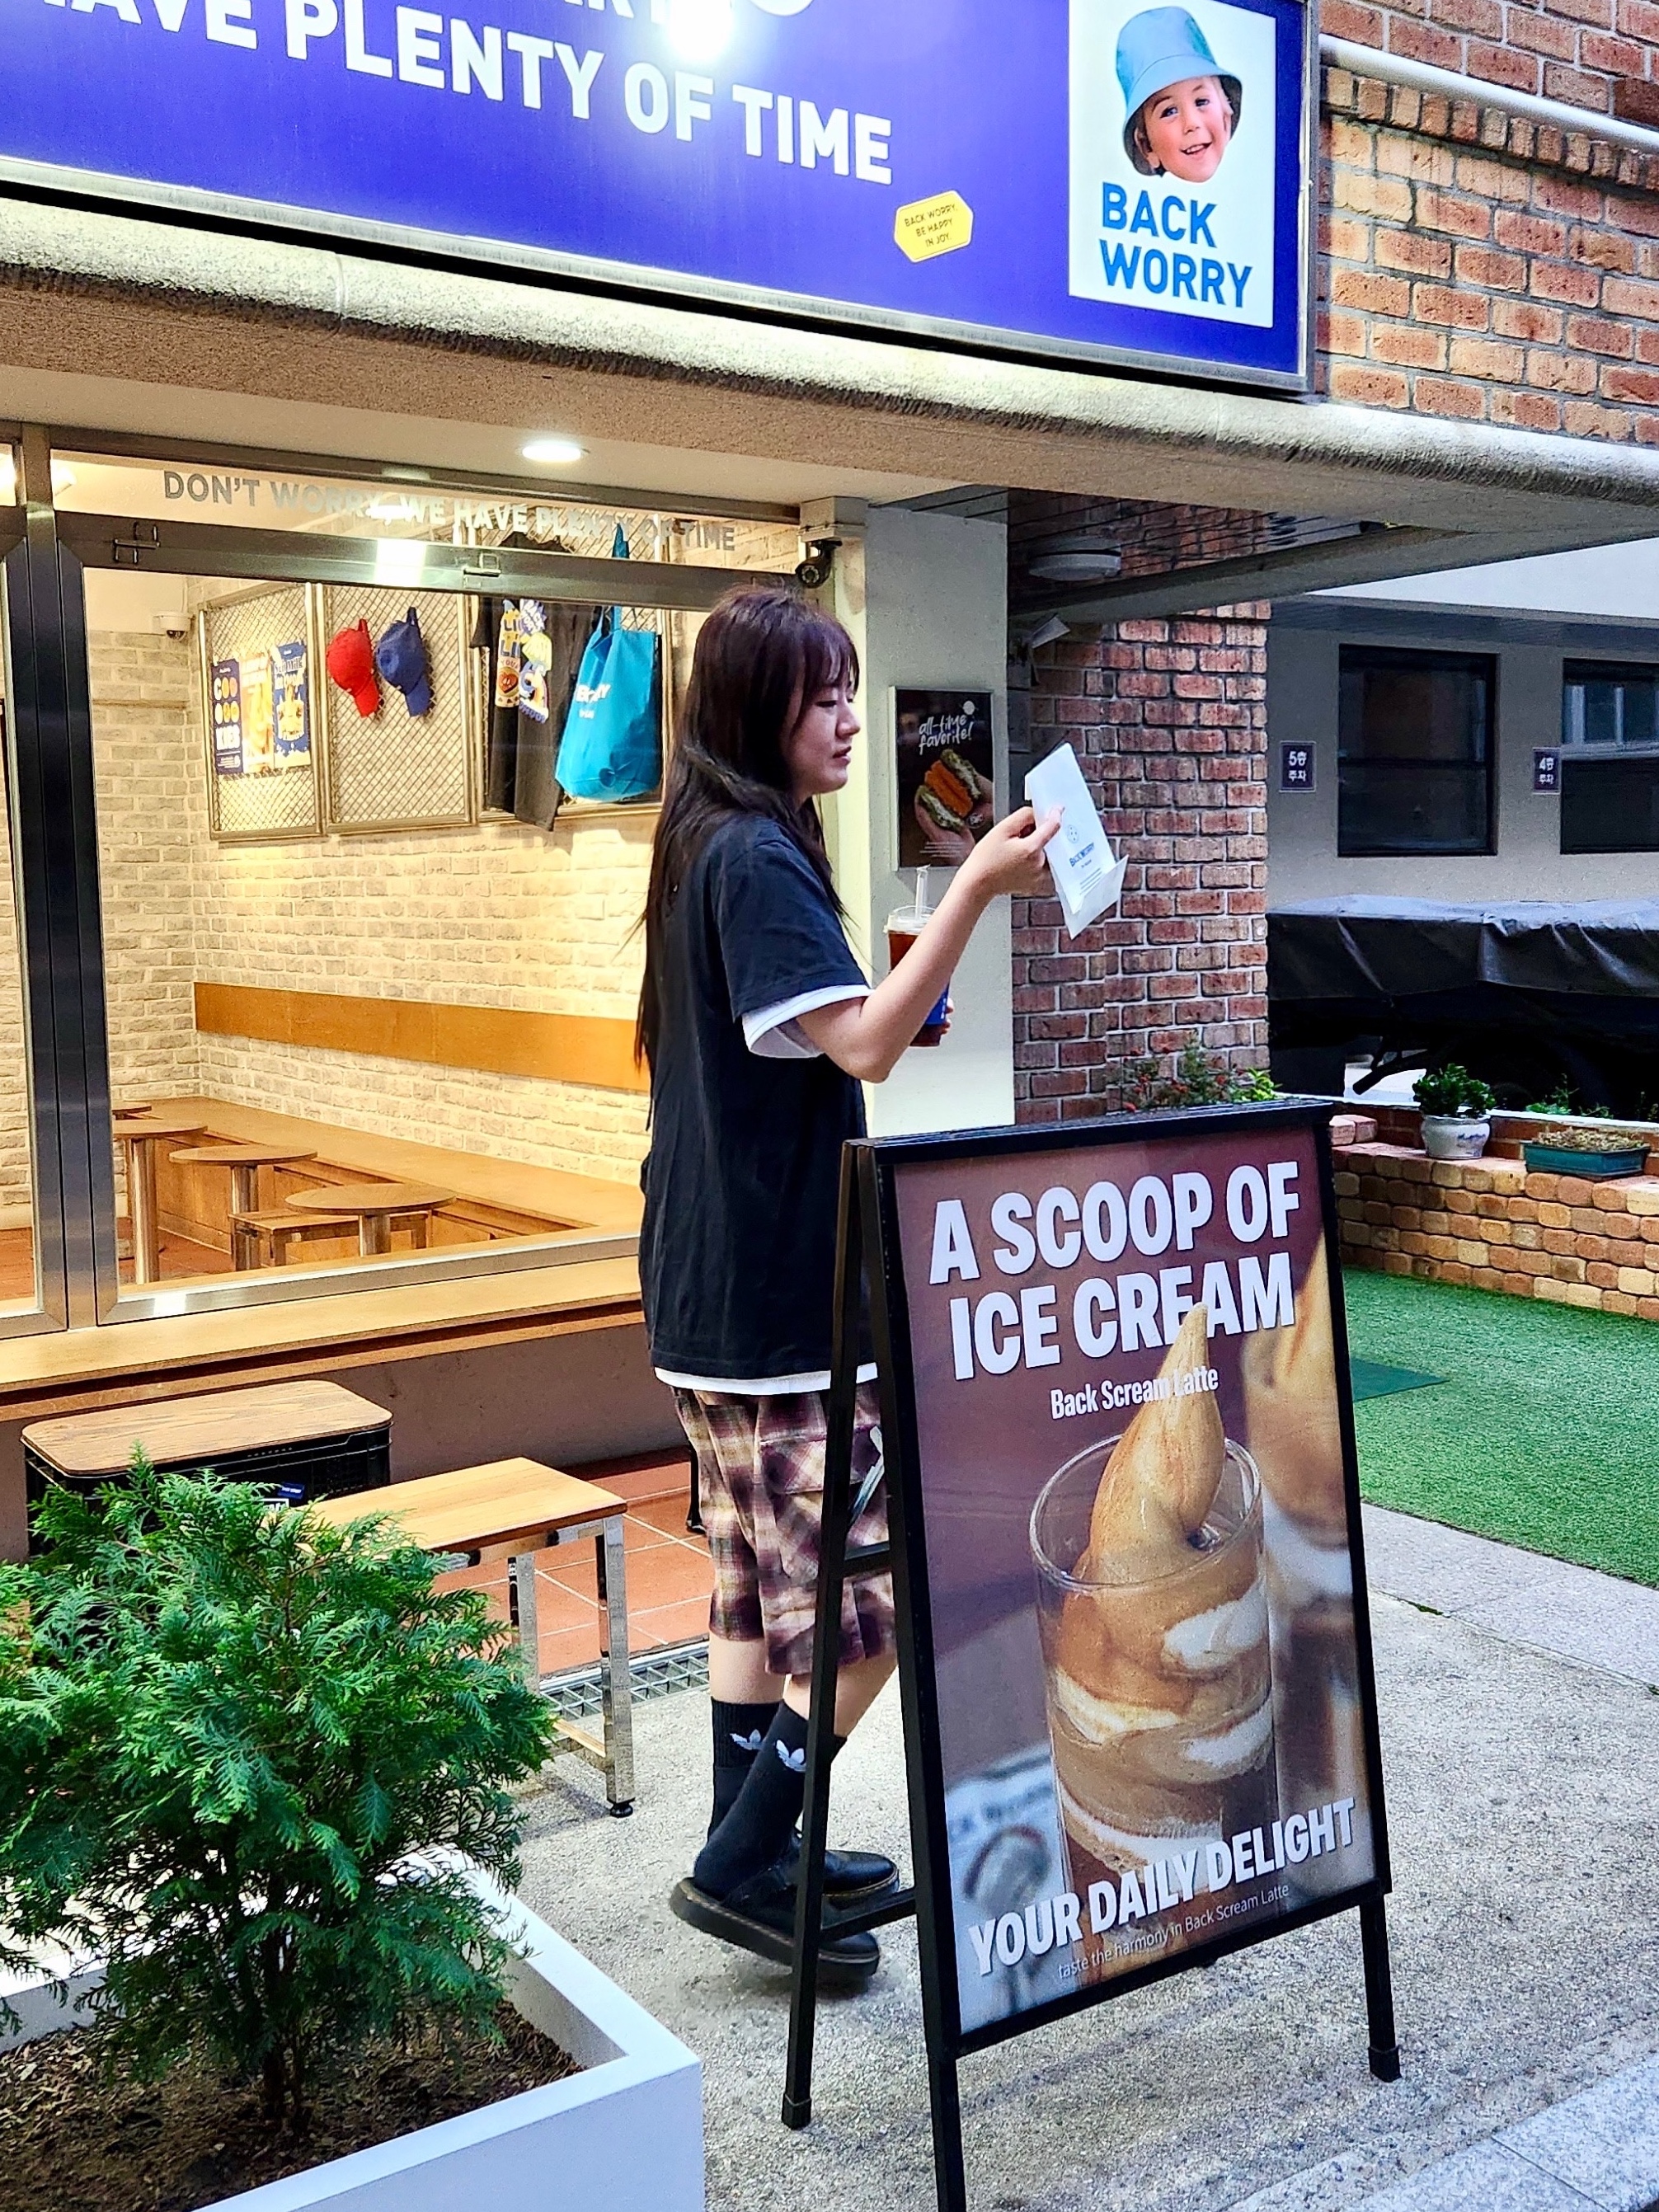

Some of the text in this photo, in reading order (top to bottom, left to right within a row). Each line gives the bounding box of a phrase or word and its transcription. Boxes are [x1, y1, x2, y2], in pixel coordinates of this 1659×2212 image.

[285, 0, 605, 120] PLENTY
[624, 62, 714, 142] OF
[732, 83, 892, 186] TIME
[904, 213, 925, 228] BACK
[915, 218, 953, 237] BE HAPPY
[925, 237, 934, 247] IN
[1102, 181, 1217, 248] BACK
[1099, 239, 1252, 308] WORRY
[163, 470, 261, 507] DON'T
[400, 494, 446, 525] WE
[454, 499, 529, 534] HAVE
[535, 505, 635, 542] PLENTY
[678, 521, 736, 552] TIME
[919, 714, 967, 735] all-time
[919, 721, 974, 756] favorite!
[928, 1161, 1299, 1284] A SCOOP OF
[949, 1252, 1297, 1380] ICE CREAM
[1050, 1365, 1219, 1420] Back Scream Latte
[967, 1797, 1356, 1976] YOUR DAILY DELIGHT
[1057, 1884, 1290, 1979] taste the harmony in Back Scream Latte
